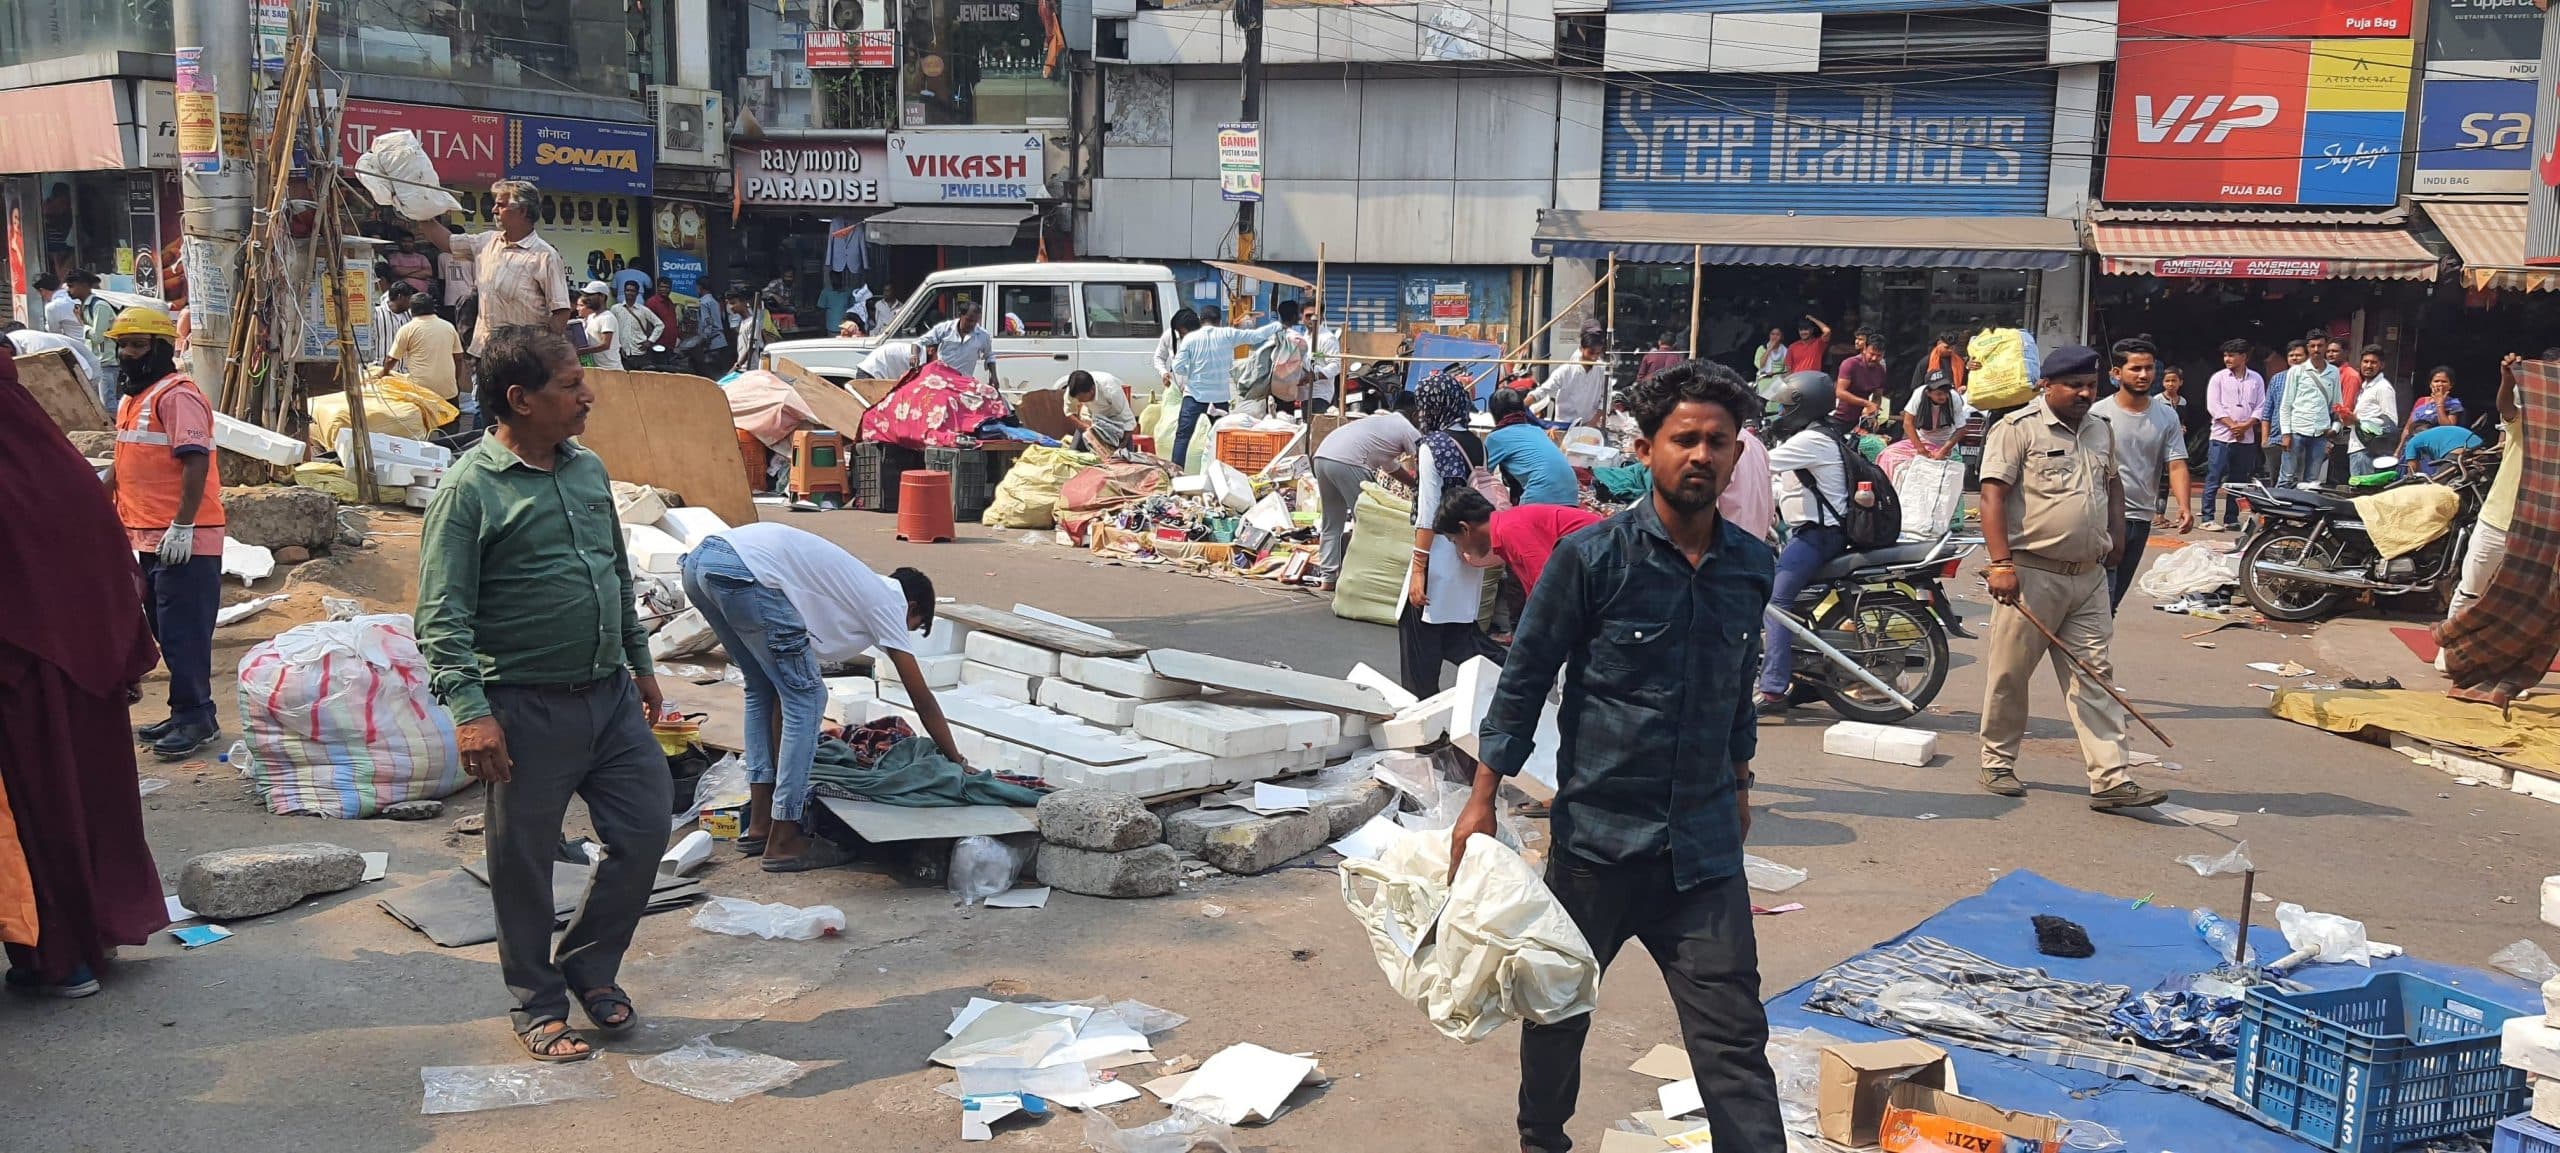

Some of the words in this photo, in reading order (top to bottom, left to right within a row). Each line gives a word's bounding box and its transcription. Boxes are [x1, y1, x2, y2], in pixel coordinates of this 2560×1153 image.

[957, 4, 1020, 22] JEWELLERS
[2346, 18, 2371, 30] Puja
[2374, 17, 2397, 30] Bag
[808, 32, 841, 48] NALANDA
[864, 32, 892, 47] CENTRE
[2509, 65, 2537, 73] INDU
[2135, 95, 2280, 143] VIP
[537, 126, 570, 140] सोनाटा
[1615, 83, 1756, 183] Sree
[390, 127, 494, 161] ITAN
[1221, 136, 1256, 147] GANDHI
[535, 143, 638, 173] SONATA
[760, 147, 861, 174] Raymond
[905, 154, 1027, 179] VIKASH
[2423, 177, 2447, 185] INDU
[2450, 177, 2470, 185] BAG
[747, 177, 878, 202] PARADISE
[941, 183, 1027, 200] JEWELLERS
[2220, 186, 2253, 195] PUJA
[2256, 186, 2283, 196] BAG
[662, 261, 702, 272] SONATA
[2161, 267, 2233, 275] TOURISTER
[2247, 268, 2319, 276] TOURISTER
[2162, 260, 2234, 268] AMERICAN
[2247, 261, 2320, 269] AMERICAN
[2341, 1066, 2360, 1144] 2023
